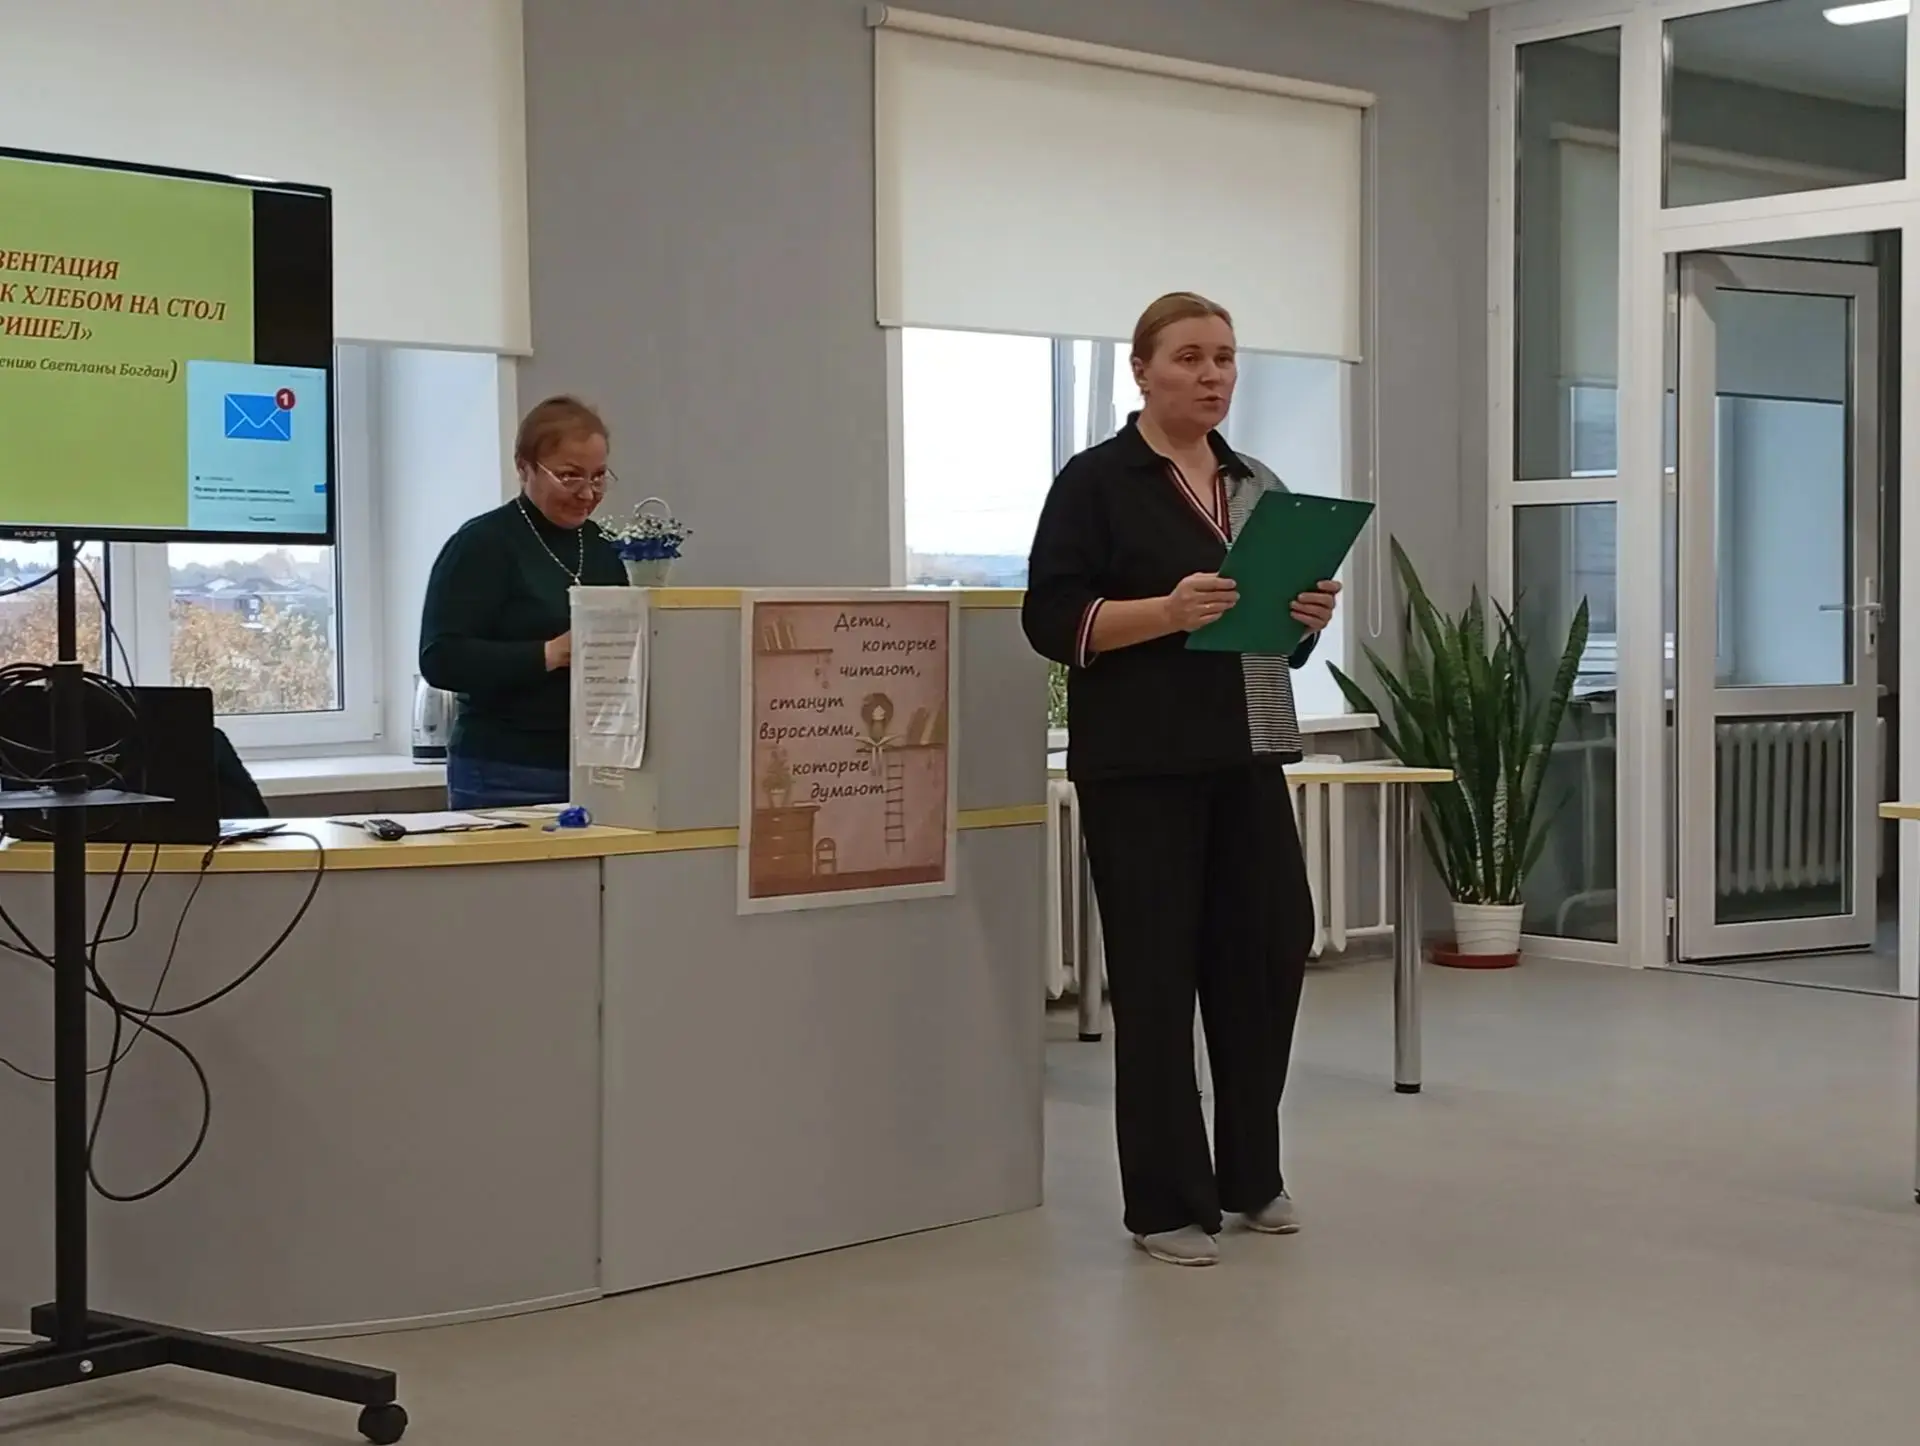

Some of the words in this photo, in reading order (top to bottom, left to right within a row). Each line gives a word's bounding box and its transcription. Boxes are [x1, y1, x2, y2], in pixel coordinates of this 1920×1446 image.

[22, 285, 124, 312] ХЛЕБОМ
[129, 294, 159, 316] НА
[167, 298, 226, 321] СТОЛ
[40, 357, 116, 375] Светланы
[120, 359, 178, 384] Богдан)
[280, 393, 289, 406] 1
[834, 612, 891, 632] Дети,
[862, 638, 937, 656] которые
[840, 664, 921, 677] читают,
[769, 696, 844, 713] станут
[759, 722, 860, 743] взрослыми,
[792, 760, 869, 778] которые
